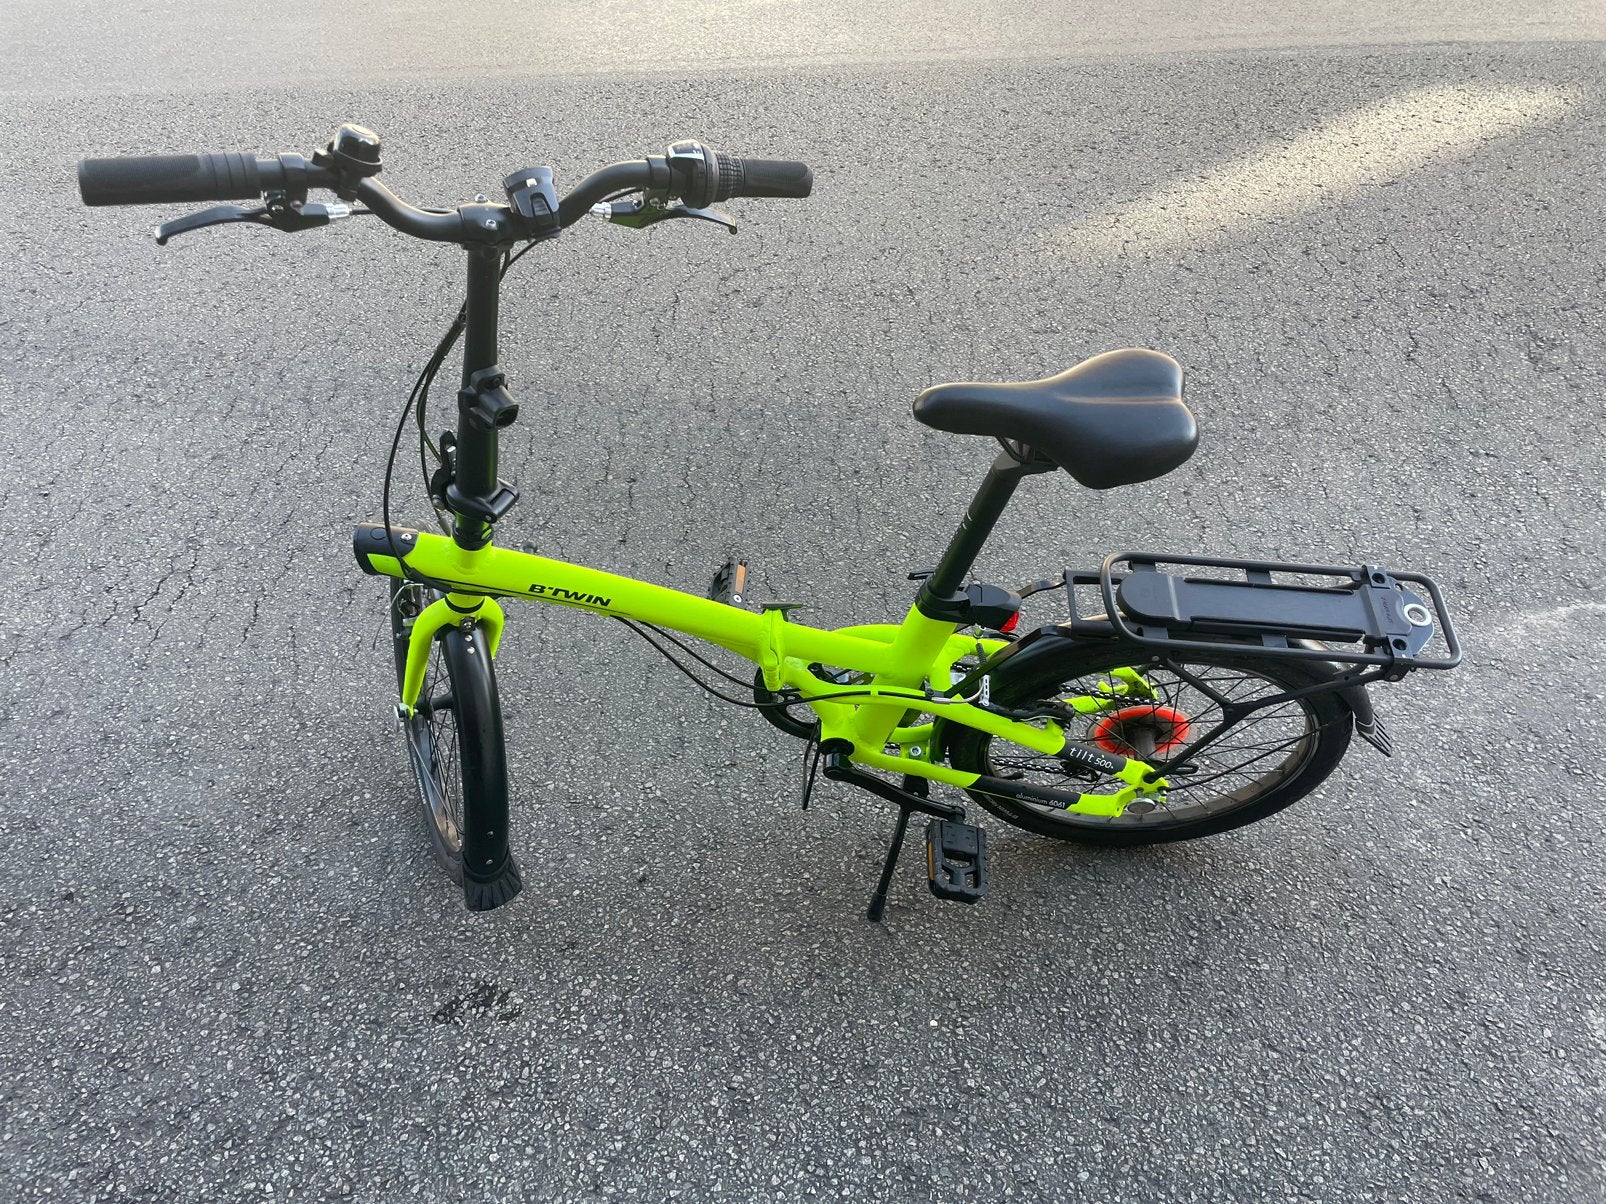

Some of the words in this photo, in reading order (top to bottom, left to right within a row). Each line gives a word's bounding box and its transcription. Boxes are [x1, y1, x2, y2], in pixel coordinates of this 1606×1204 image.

[1069, 747, 1095, 763] tilt
[1015, 792, 1048, 805] aluminium
[1048, 799, 1066, 809] 6061
